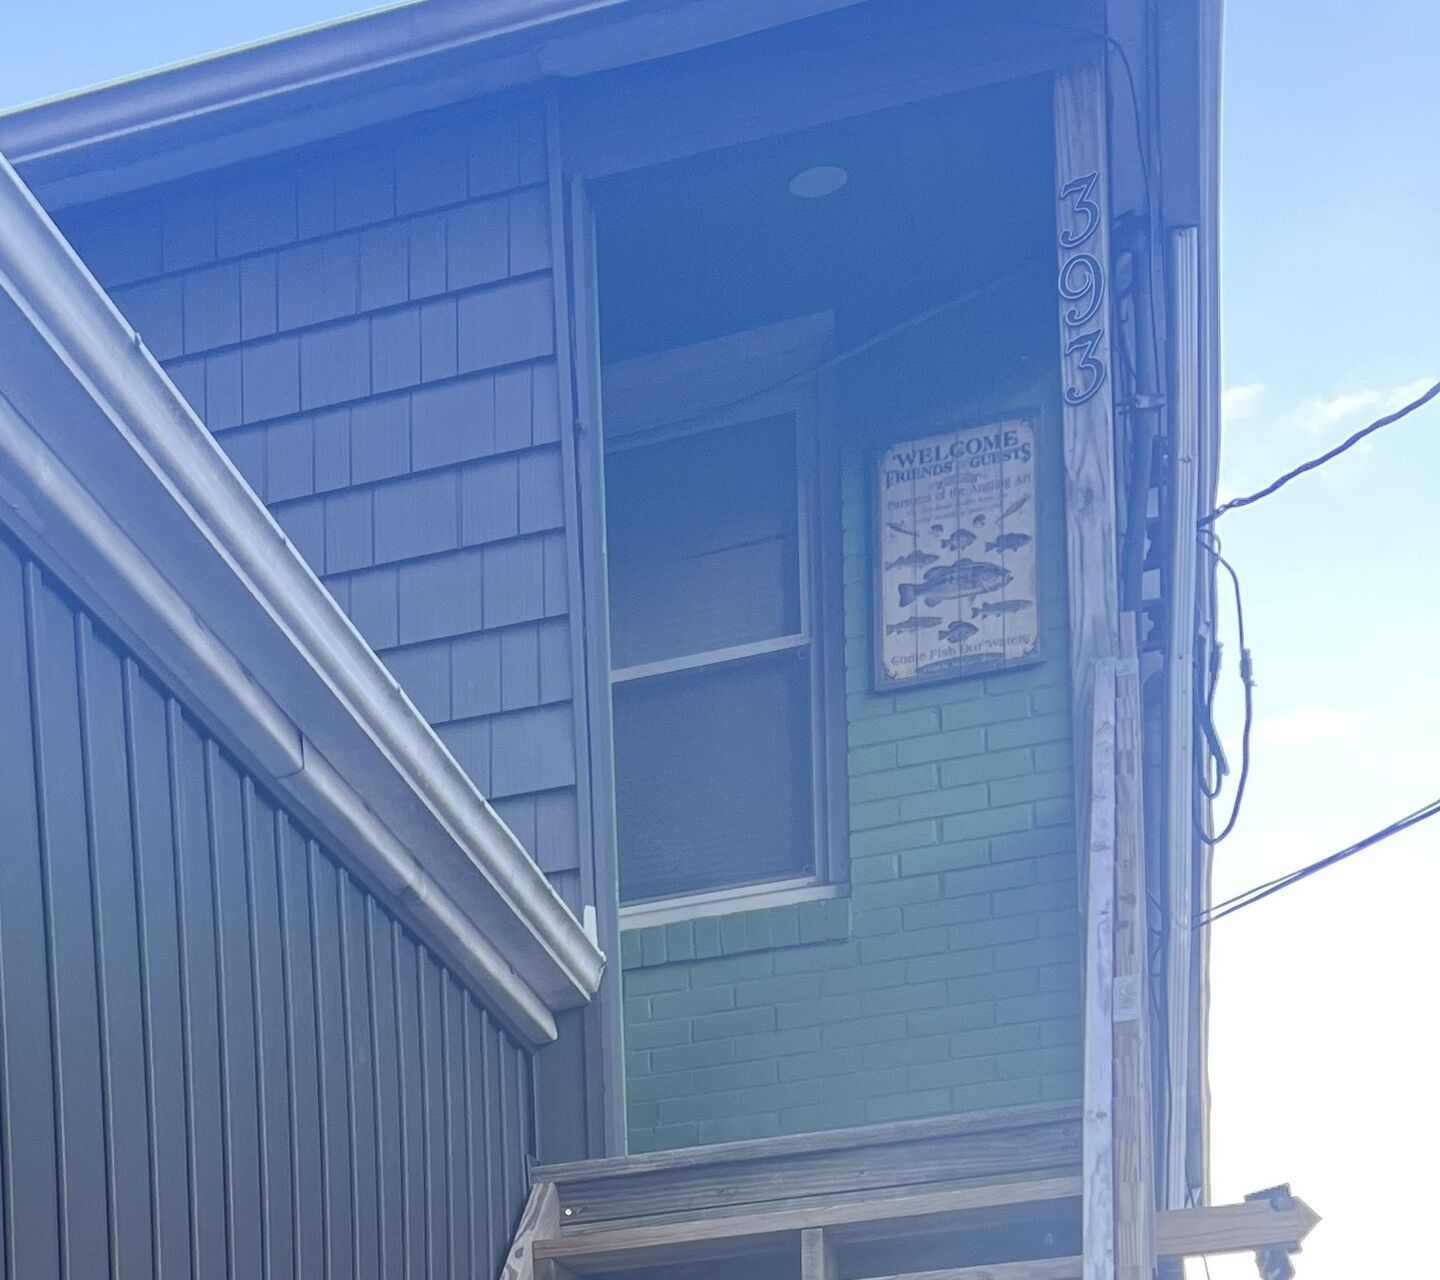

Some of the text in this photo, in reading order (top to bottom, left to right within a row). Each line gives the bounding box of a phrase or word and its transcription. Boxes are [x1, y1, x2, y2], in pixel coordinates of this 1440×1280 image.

[1057, 169, 1107, 407] 393
[883, 460, 954, 488] FRIENDS
[969, 442, 1032, 469] GUESTS
[892, 430, 1019, 468] WELCOME
[930, 645, 957, 660] Fish
